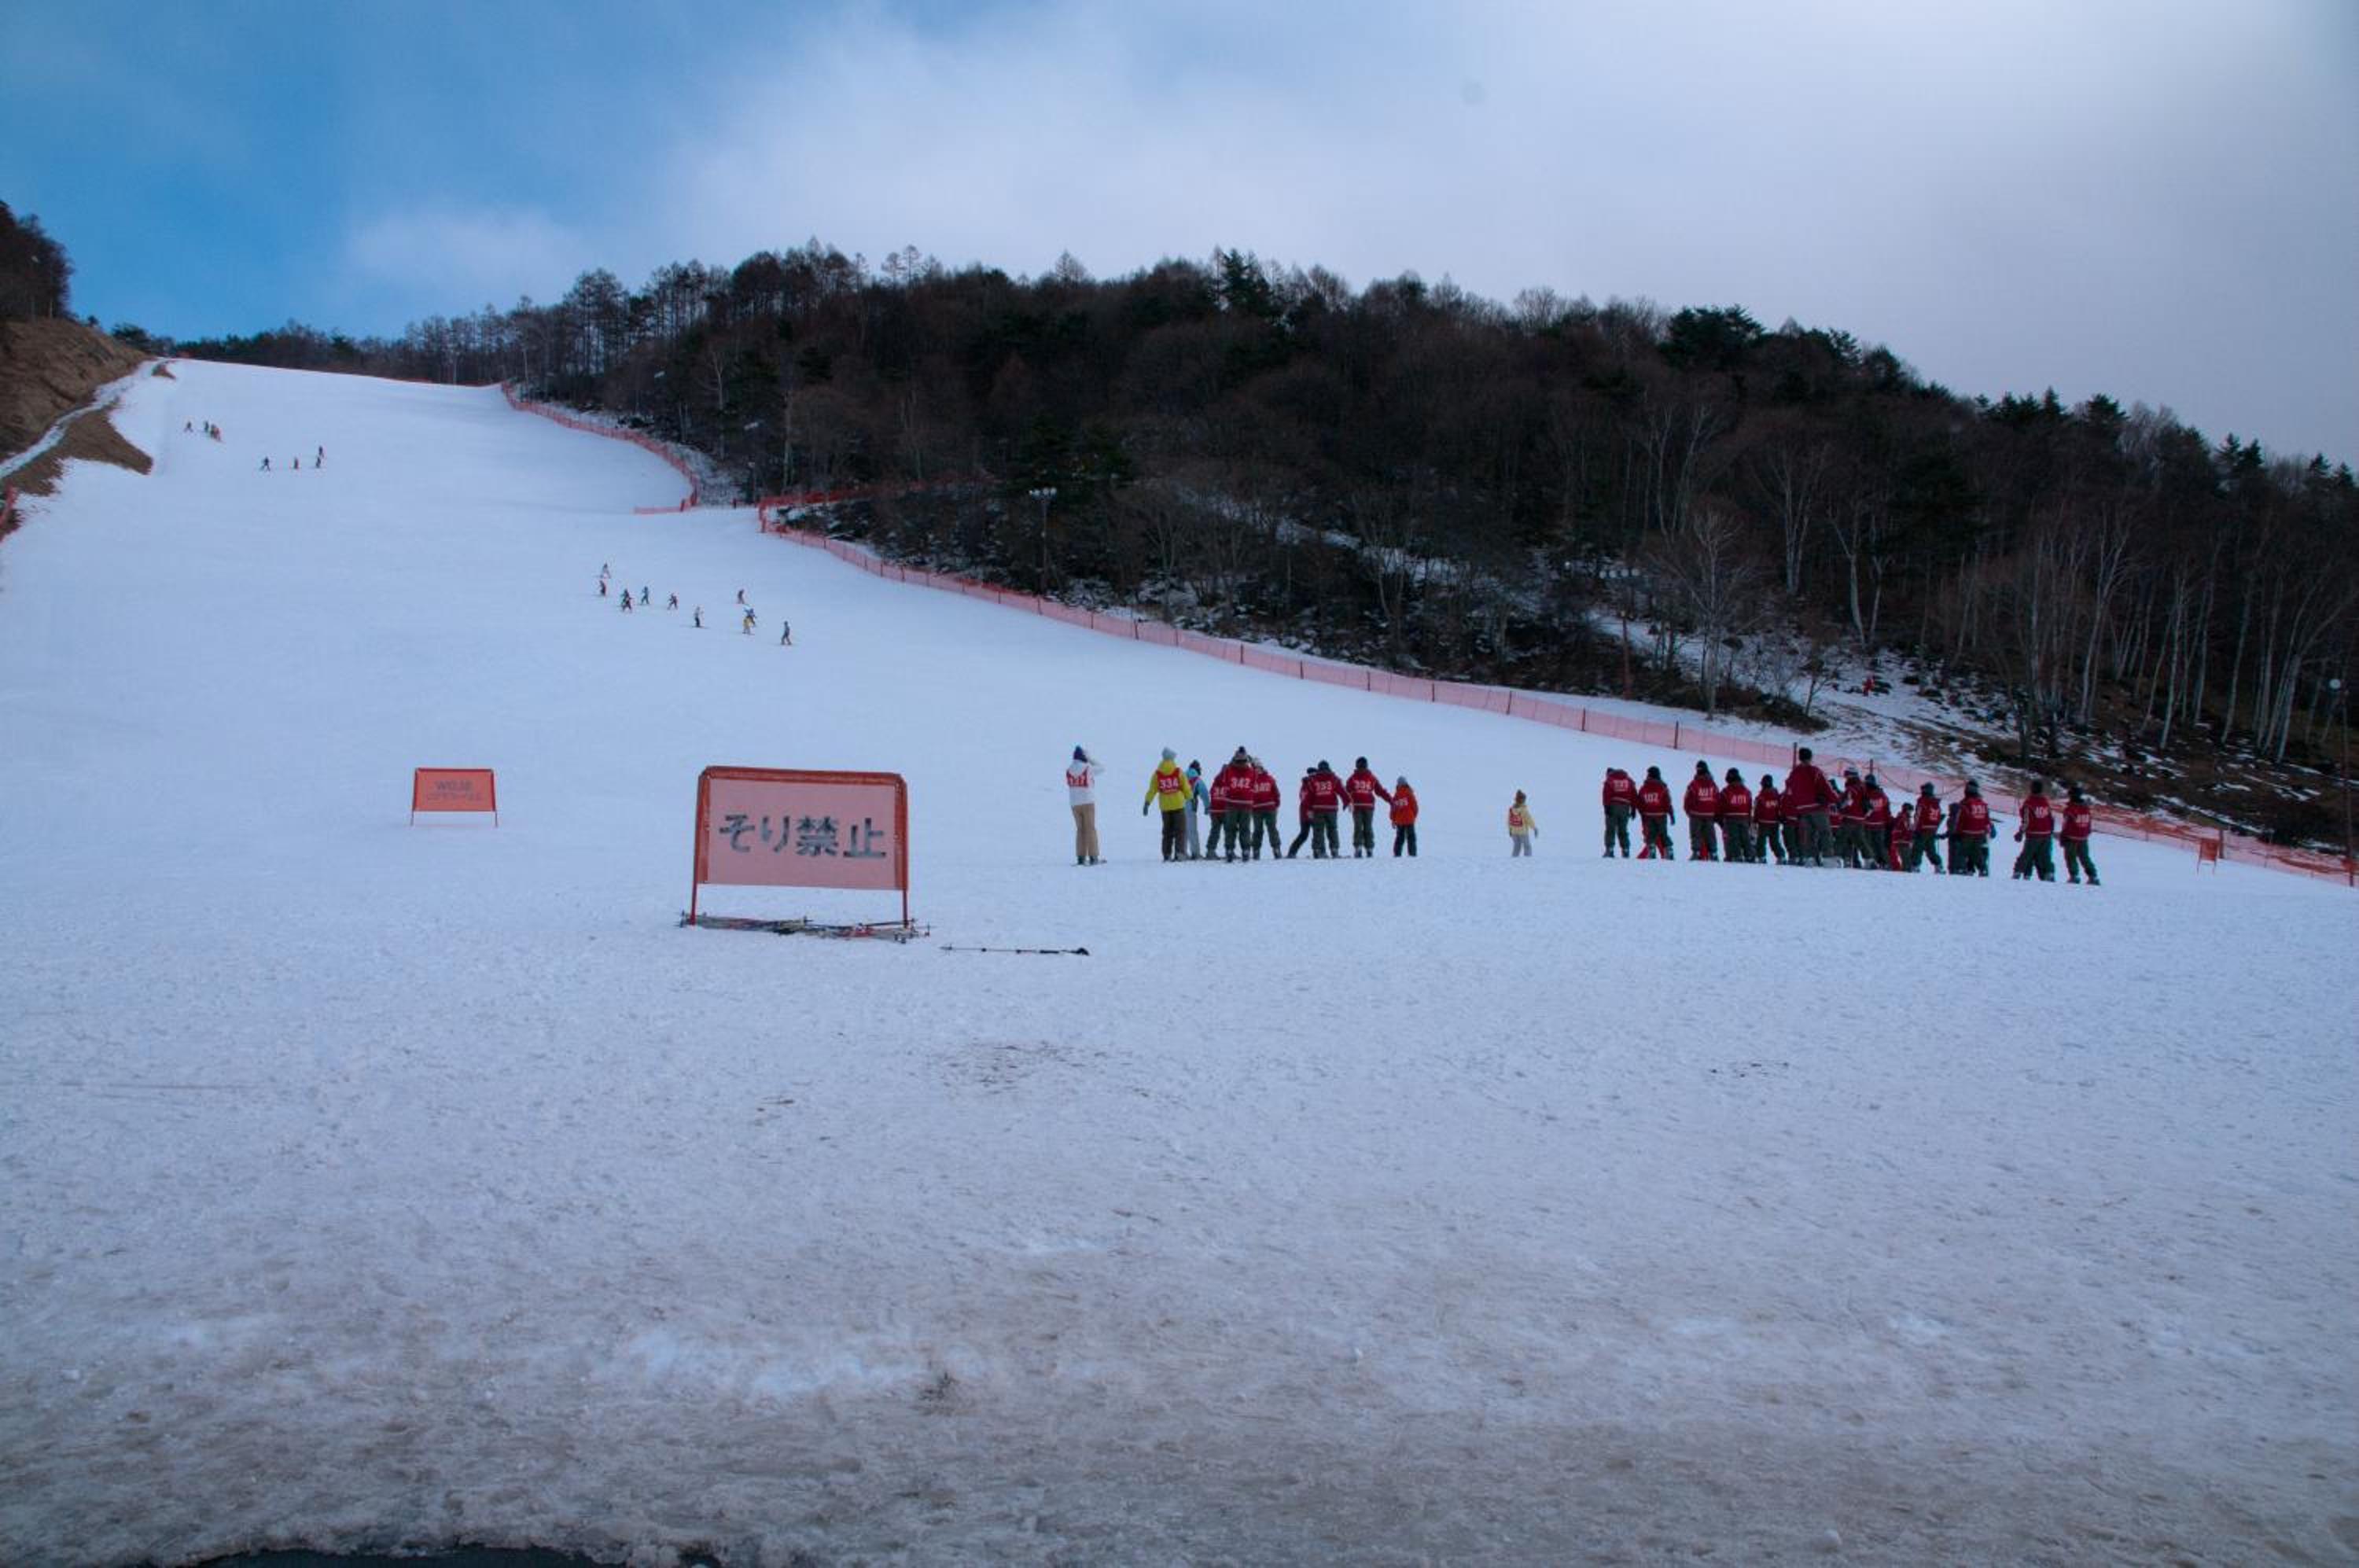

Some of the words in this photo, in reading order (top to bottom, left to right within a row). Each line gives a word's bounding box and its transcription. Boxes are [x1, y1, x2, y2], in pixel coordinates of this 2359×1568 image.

[1231, 777, 1251, 789] 342
[719, 814, 886, 858] そり禁止
